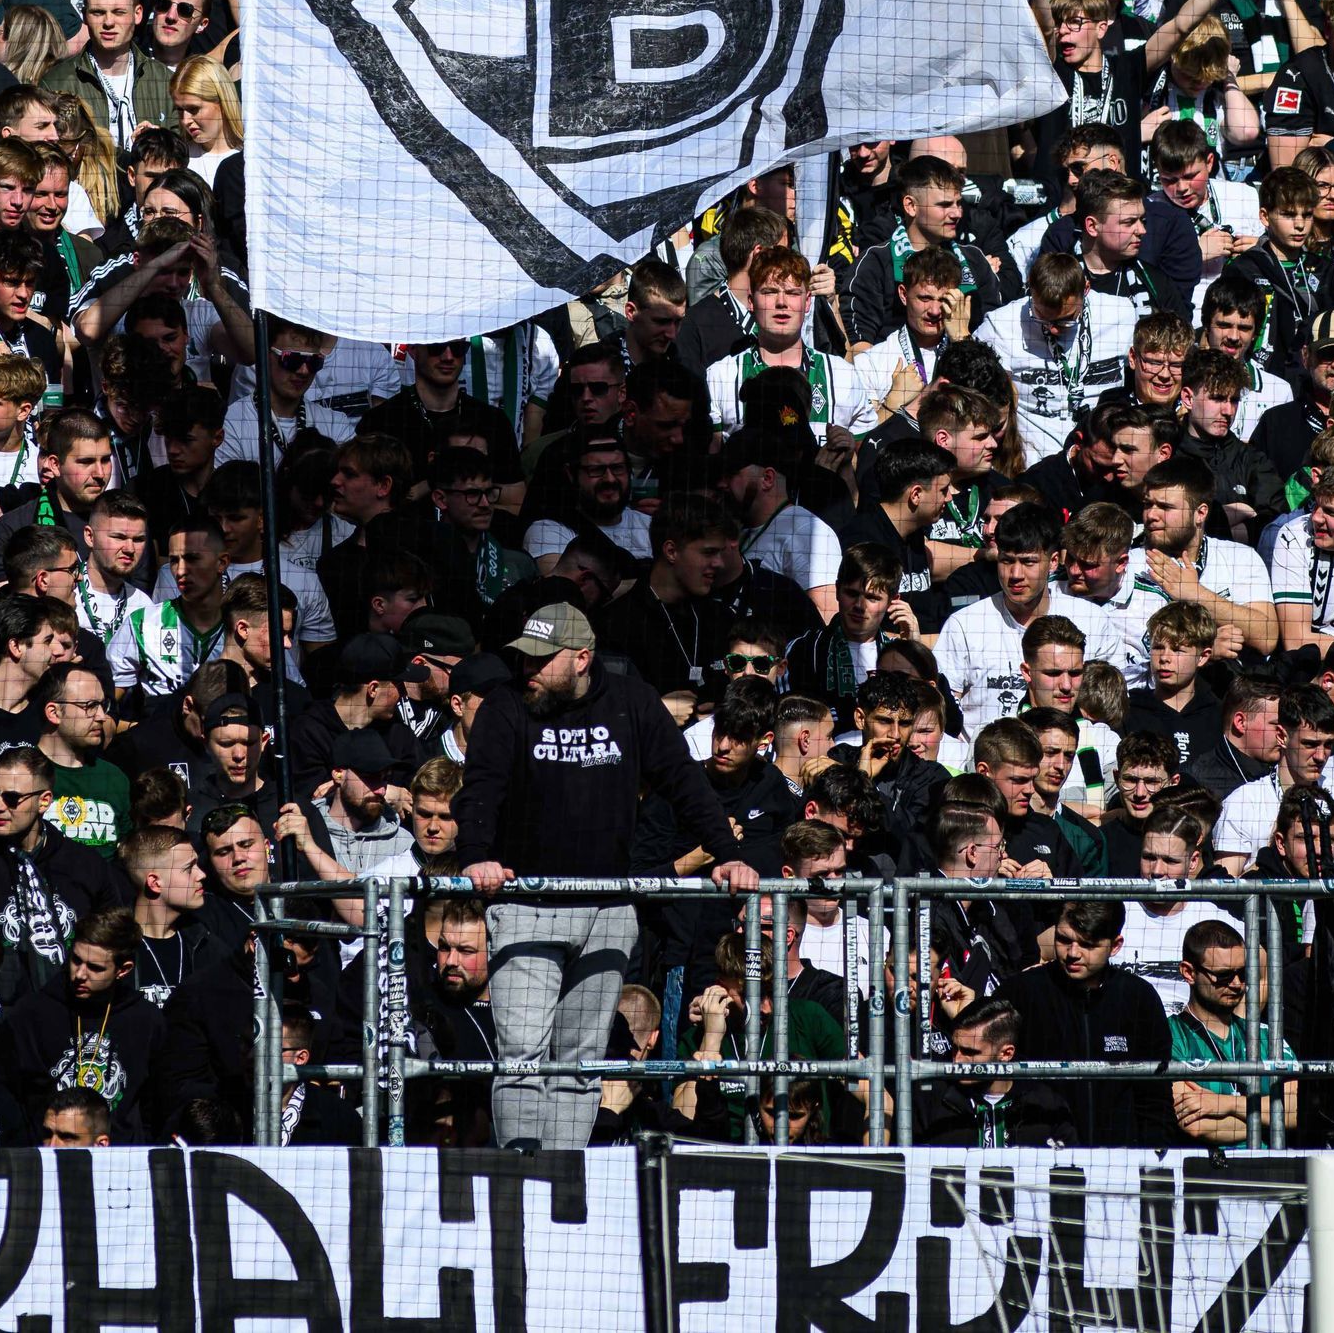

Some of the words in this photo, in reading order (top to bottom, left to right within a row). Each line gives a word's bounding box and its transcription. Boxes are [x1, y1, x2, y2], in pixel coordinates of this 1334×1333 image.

[542, 727, 610, 744] SOTTO
[534, 742, 621, 763] CULTURA
[552, 878, 621, 891] SOTTOCULTURA
[847, 916, 858, 992] SOTTOCULTURA
[920, 908, 931, 984] SOTTOCULTURA
